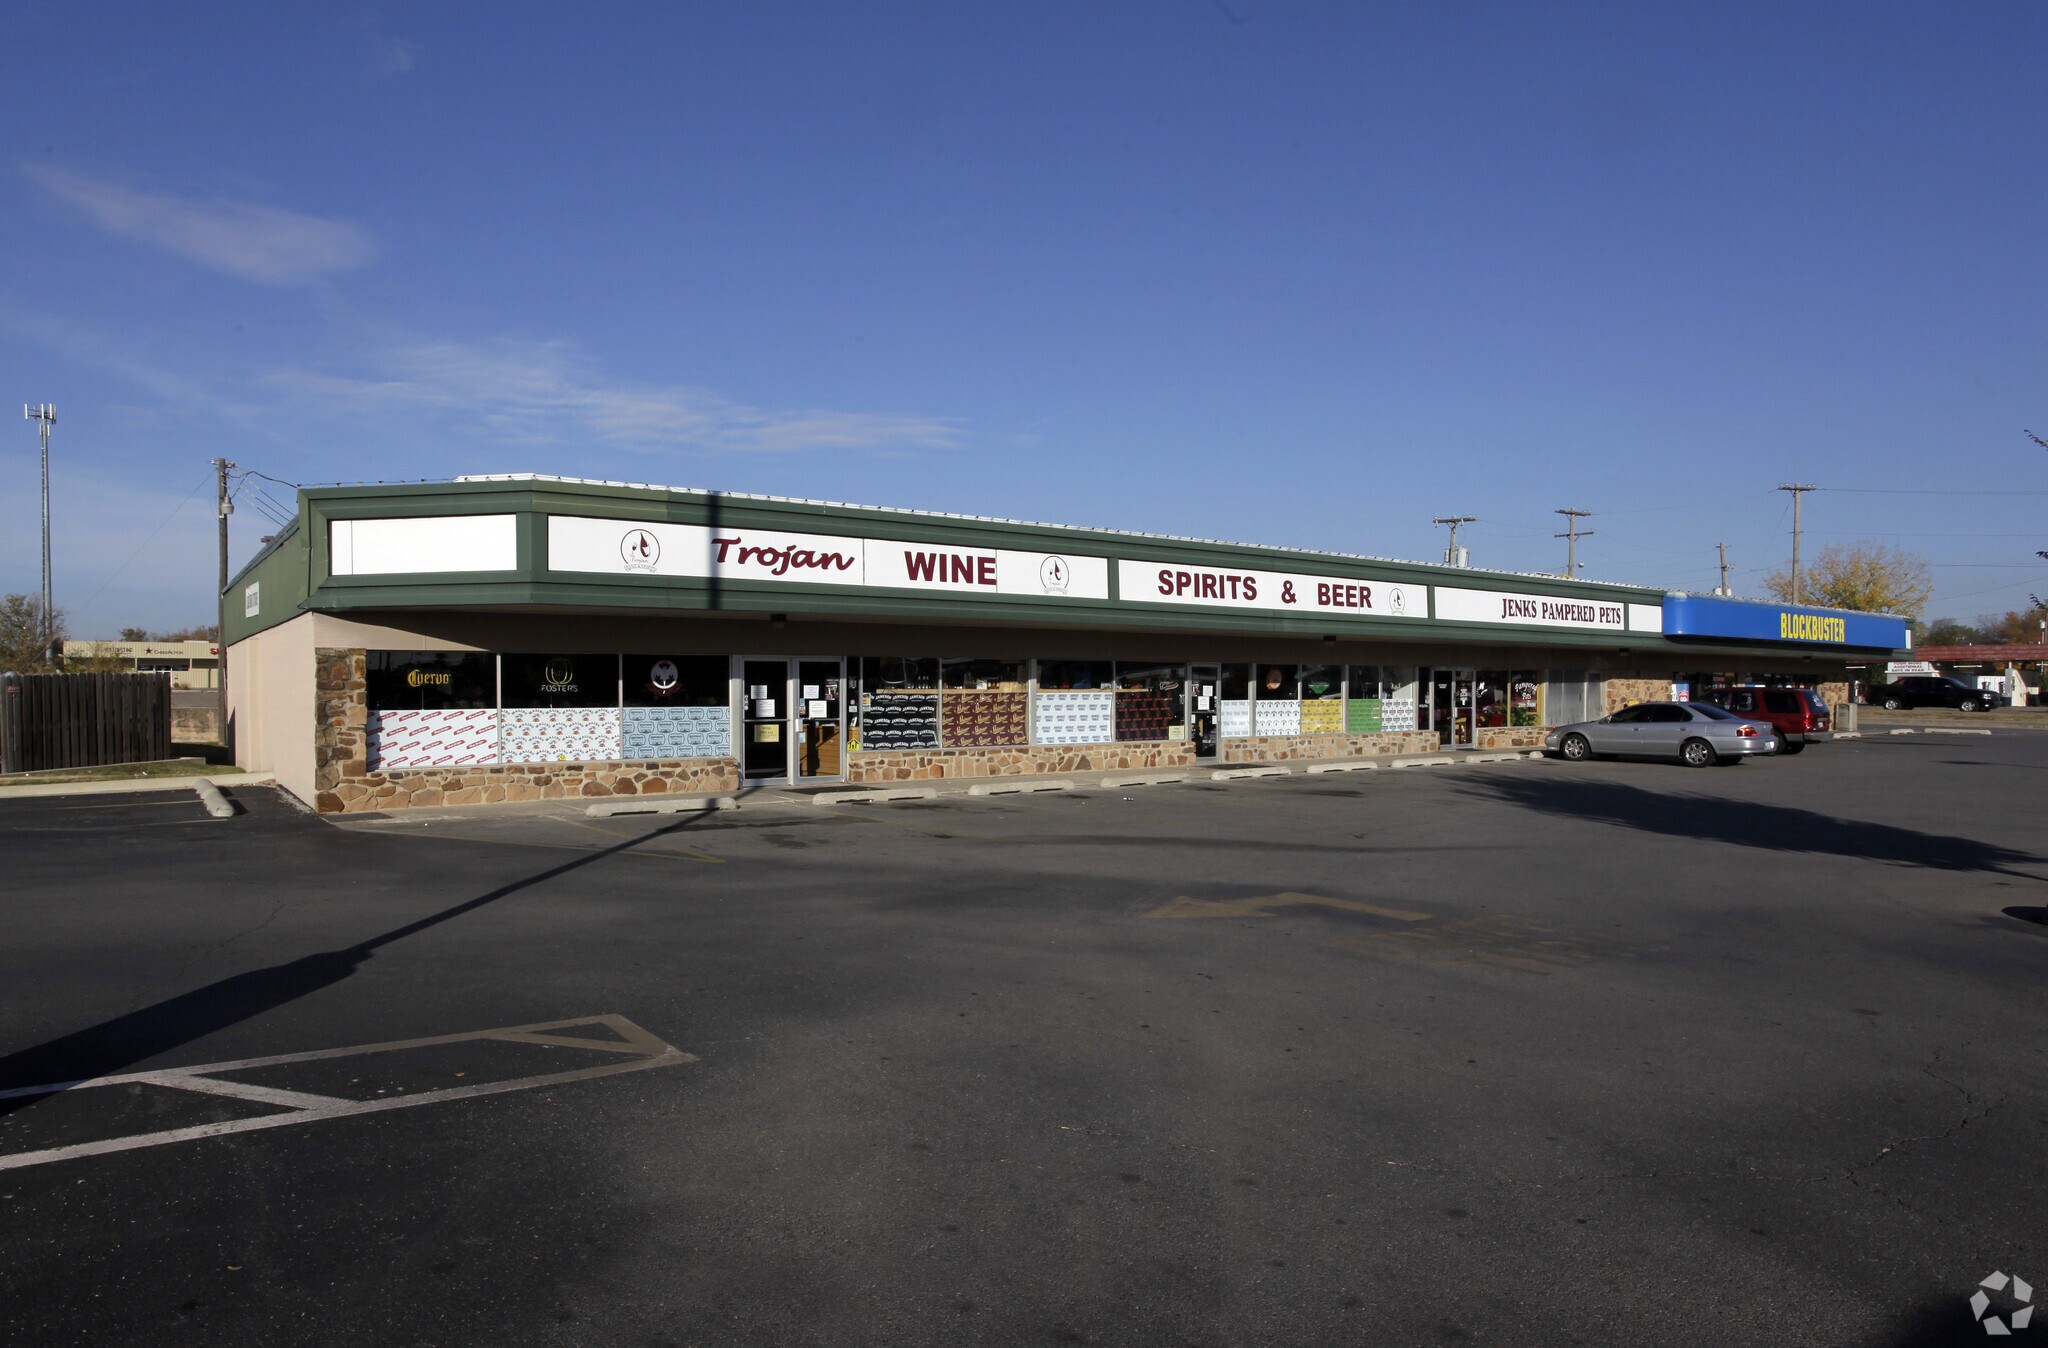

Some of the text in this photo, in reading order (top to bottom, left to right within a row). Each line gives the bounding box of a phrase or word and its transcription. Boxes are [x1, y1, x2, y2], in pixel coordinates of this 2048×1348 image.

[711, 536, 997, 586] Trojan WINE
[1158, 569, 1372, 608] SPIRITS & BEER
[1502, 598, 1620, 624] JENKS PAMPERED PETS
[1780, 612, 1845, 642] BLOCKBUSTER
[408, 669, 450, 687] Cuervo
[541, 684, 578, 692] FOSTER'S
